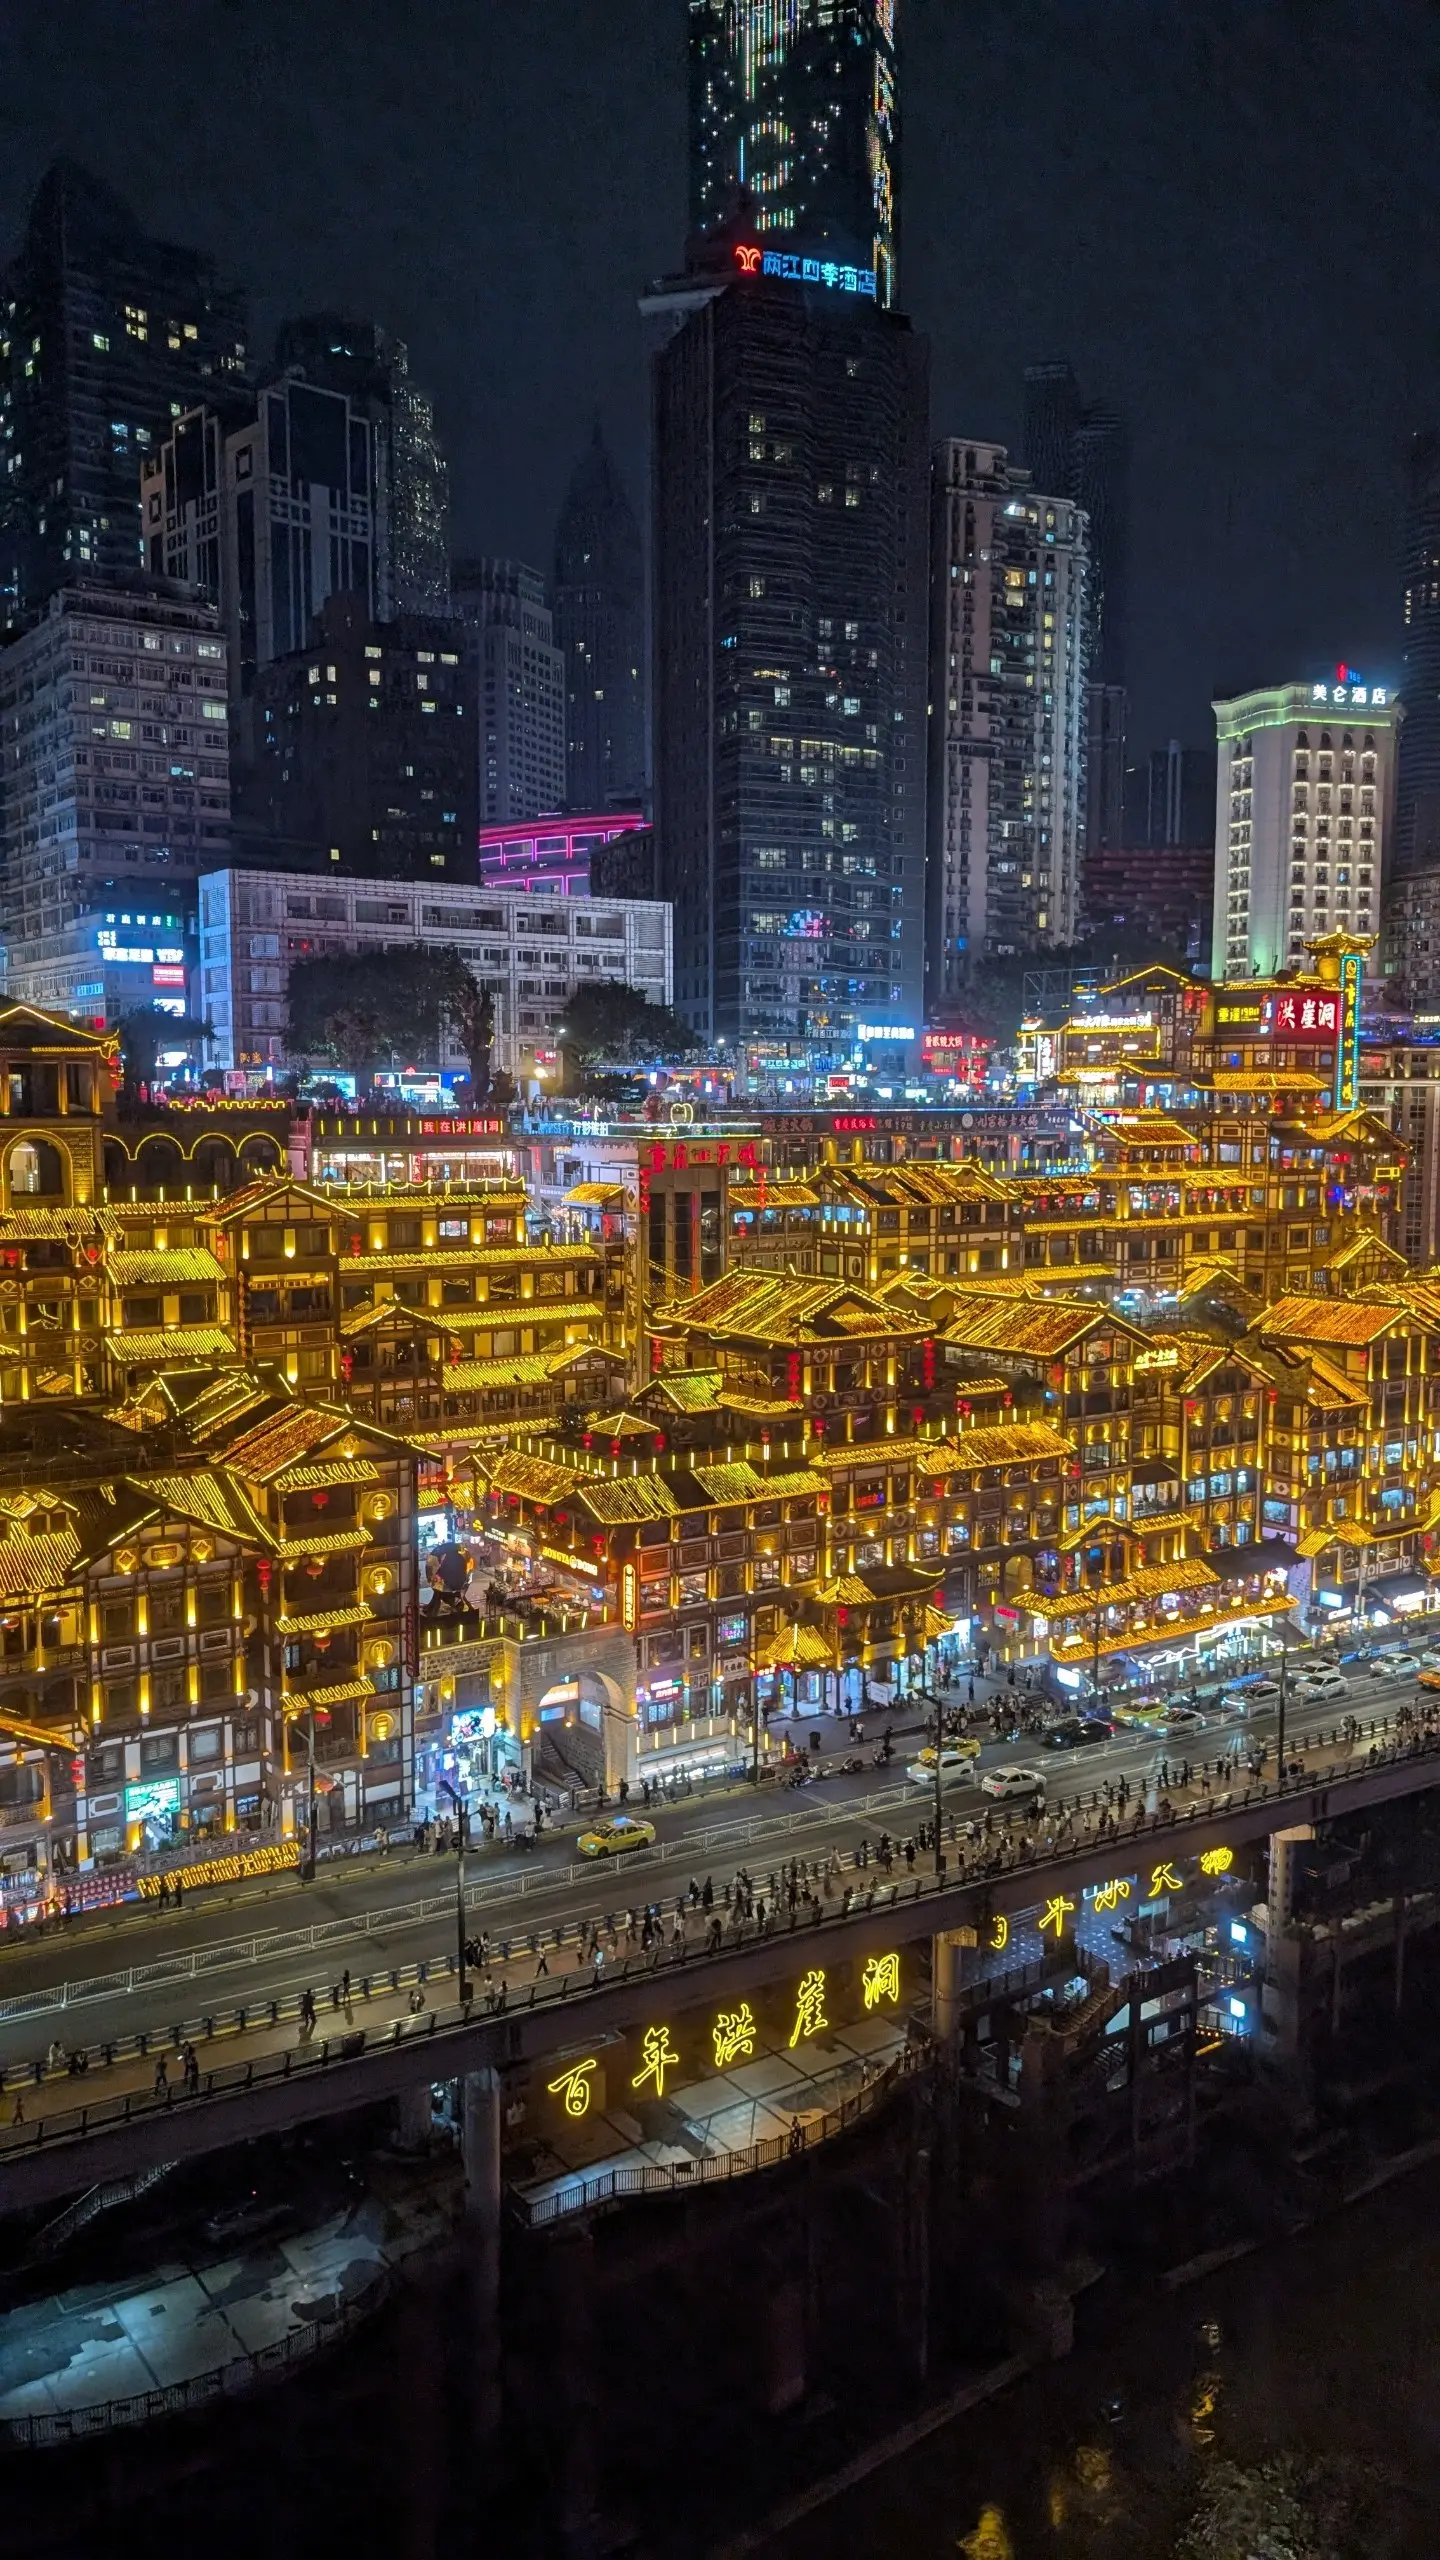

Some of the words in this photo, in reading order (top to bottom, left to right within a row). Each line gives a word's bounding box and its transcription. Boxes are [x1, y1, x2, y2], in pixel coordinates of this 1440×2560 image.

[762, 250, 877, 295] 两江四季酒店
[1312, 684, 1387, 705] 美仑酒店
[1277, 997, 1336, 1030] 洪崖洞
[423, 1119, 500, 1134] 我在洪崖洞
[547, 1953, 900, 2116] 百年洪崖洞
